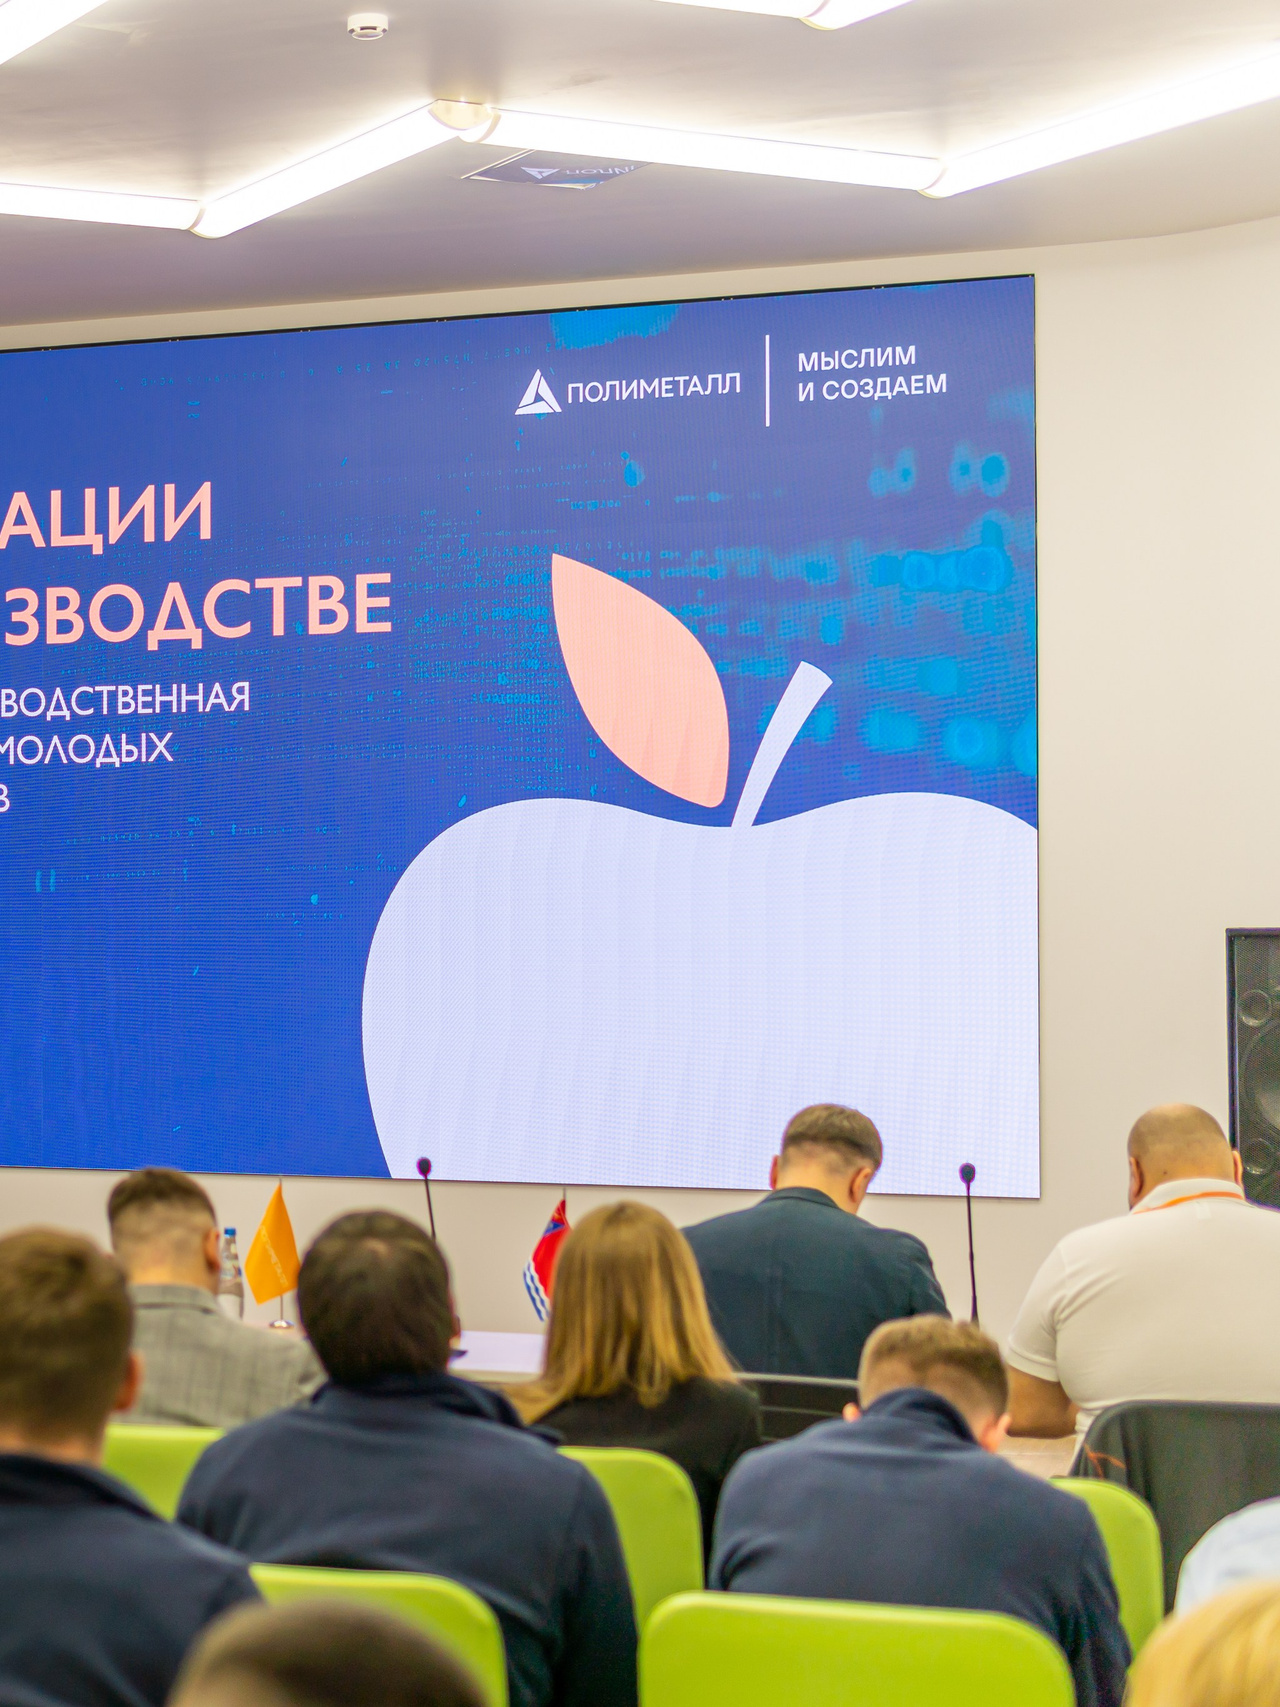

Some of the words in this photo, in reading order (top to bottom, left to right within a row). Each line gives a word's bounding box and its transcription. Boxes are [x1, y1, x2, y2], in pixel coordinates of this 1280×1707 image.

[798, 345, 916, 372] МЫСЛИМ
[567, 373, 741, 404] ПОЛИМЕТАЛЛ
[798, 382, 814, 402] И
[822, 373, 947, 401] СОЗДАЕМ
